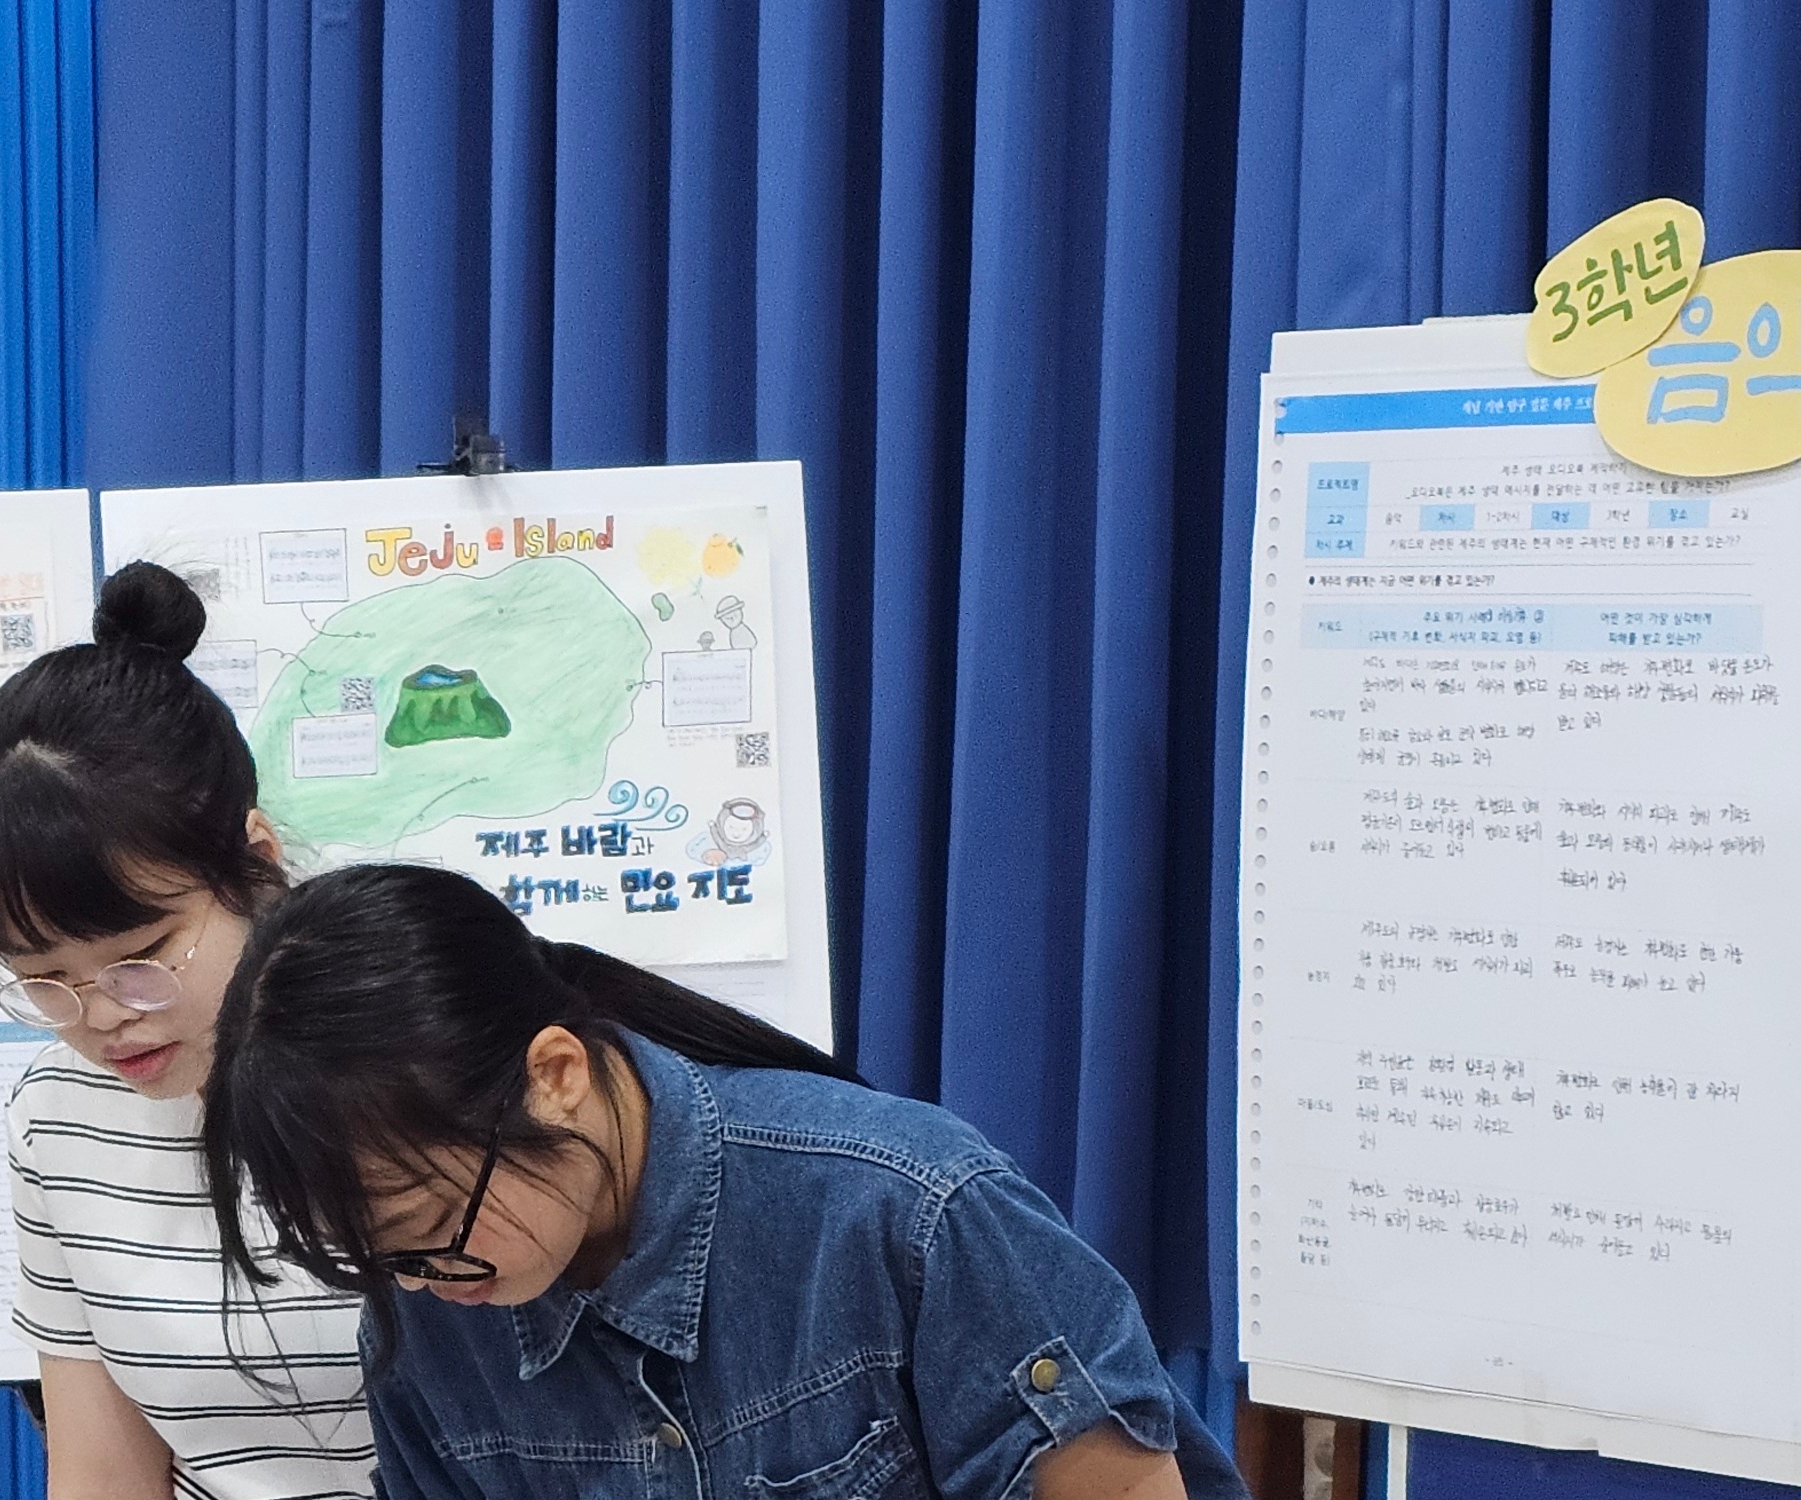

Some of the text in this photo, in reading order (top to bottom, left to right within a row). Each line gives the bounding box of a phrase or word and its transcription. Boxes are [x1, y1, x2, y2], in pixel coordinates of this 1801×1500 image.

[1545, 220, 1689, 344] 3학년
[1548, 463, 1583, 475] 오디오북
[1551, 511, 1571, 524] 대상
[1669, 508, 1687, 522] 장소
[365, 515, 615, 576] Jeju Island
[477, 822, 654, 858] 제주 바람과
[620, 867, 680, 914] 민요
[687, 864, 754, 905] 지도
